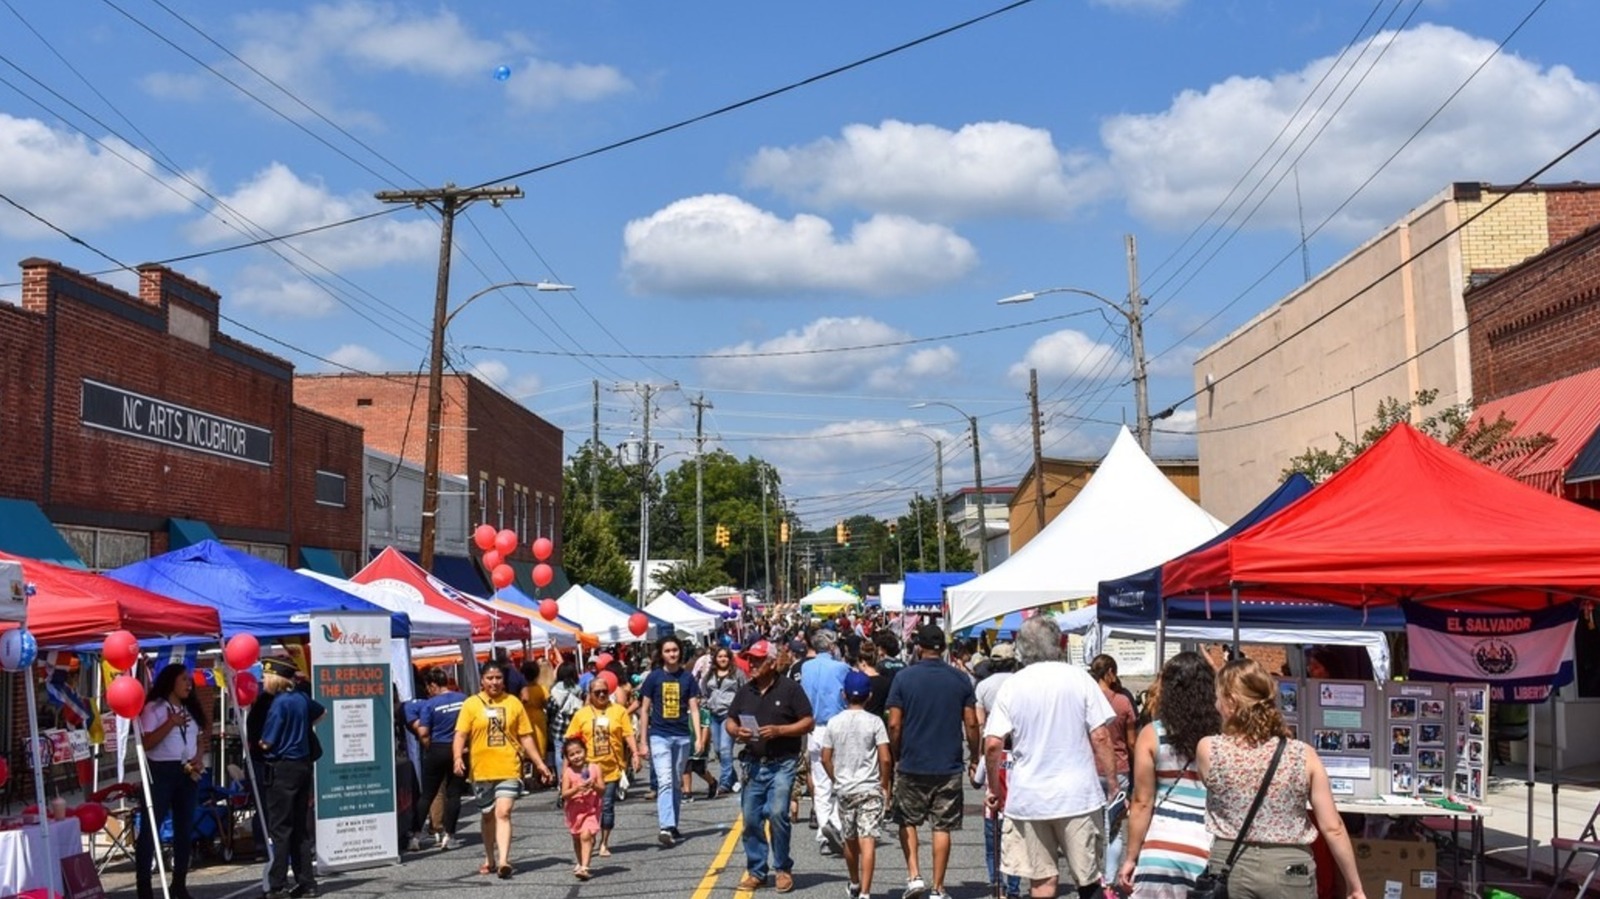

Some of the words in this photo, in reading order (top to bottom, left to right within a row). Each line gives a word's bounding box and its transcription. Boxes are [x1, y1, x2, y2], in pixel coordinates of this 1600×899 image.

[122, 395, 143, 431] NC
[148, 402, 183, 441] ARTS
[186, 412, 247, 456] INCUBATOR
[1446, 616, 1463, 632] EL
[1465, 616, 1532, 632] SALVADOR
[321, 669, 332, 681] EL
[335, 667, 383, 681] REFUGIO
[319, 684, 341, 697] THE
[343, 683, 385, 697] REFUGE
